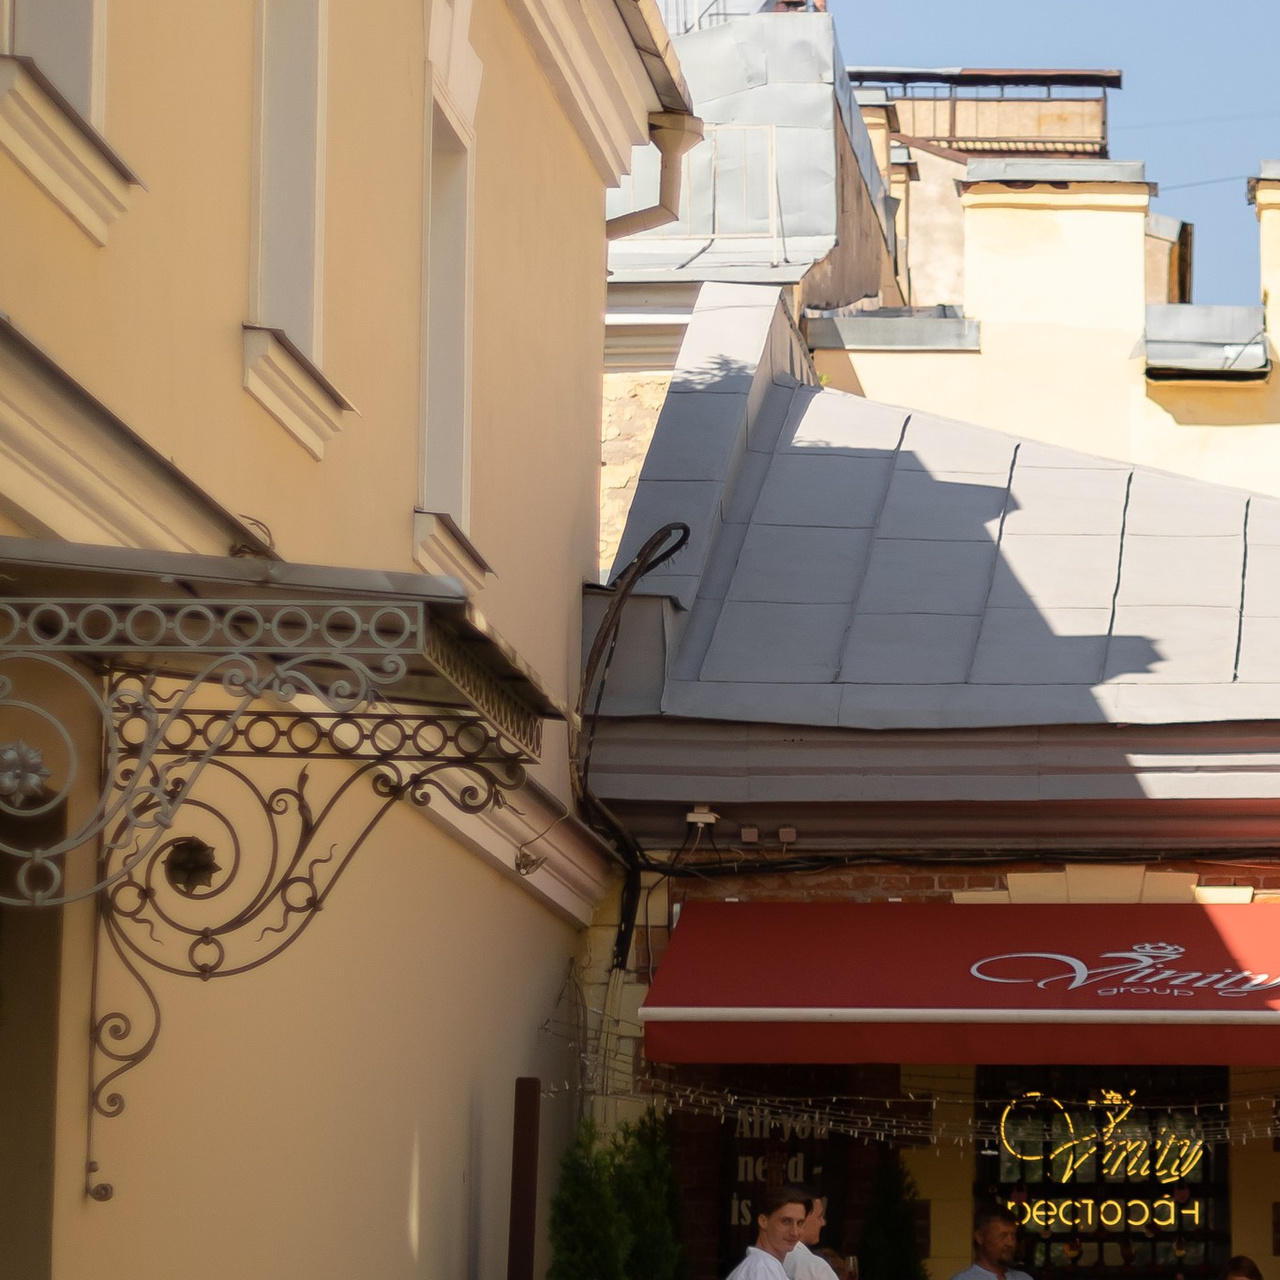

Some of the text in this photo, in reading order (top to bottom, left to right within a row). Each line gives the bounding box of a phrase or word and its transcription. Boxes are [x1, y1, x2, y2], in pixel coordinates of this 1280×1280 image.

[1097, 986, 1194, 997] group
[735, 1107, 829, 1142] All you
[1001, 1091, 1203, 1183] Vinity
[738, 1152, 804, 1182] ned
[730, 1193, 752, 1225] is
